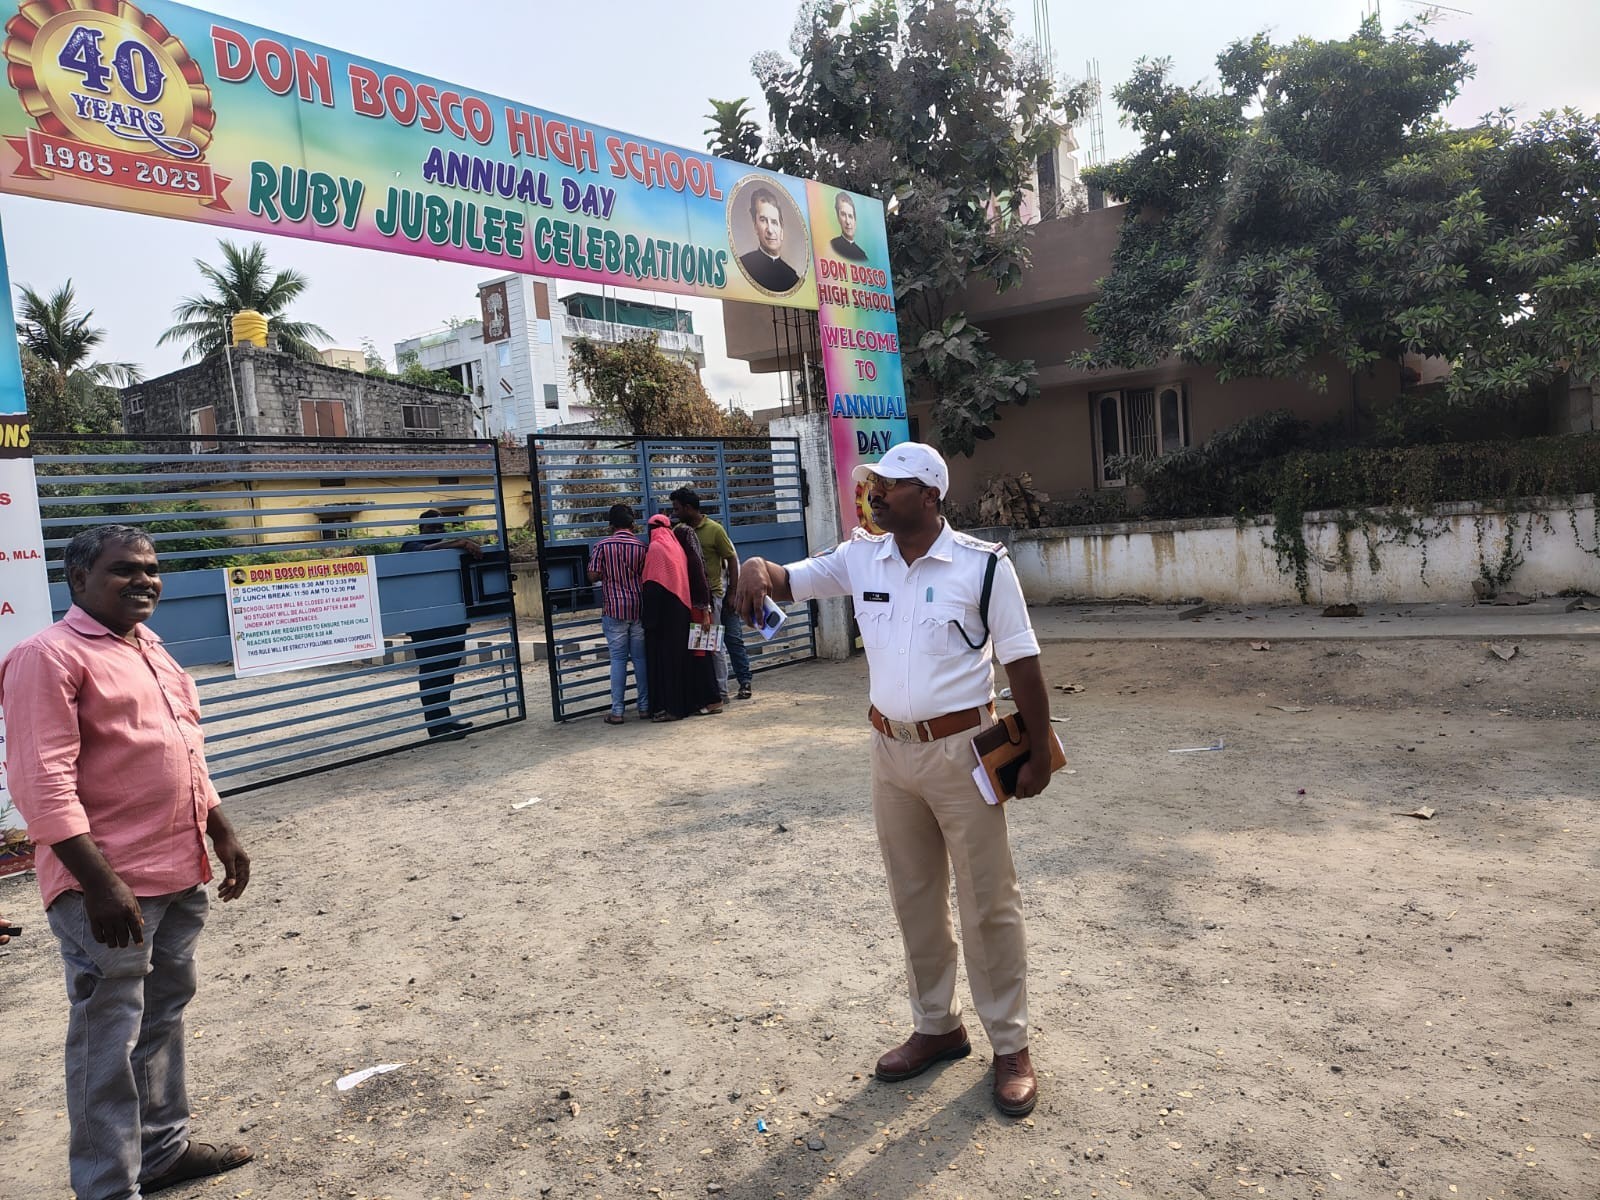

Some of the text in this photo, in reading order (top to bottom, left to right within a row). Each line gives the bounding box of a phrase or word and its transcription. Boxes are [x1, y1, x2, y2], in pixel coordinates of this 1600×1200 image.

[57, 25, 166, 103] 40
[210, 24, 722, 200] DON BOSCO HIGH SCHOOL
[43, 143, 114, 176] 1985
[136, 161, 200, 192] 2025
[422, 146, 616, 219] ANNUAL DAY
[249, 160, 728, 288] RUBY JUBILEE CELEBRATIONS
[820, 258, 886, 289] DON BOSCO
[818, 283, 895, 313] HIGH SCHOOL
[823, 325, 898, 353] WELCOME
[855, 359, 877, 381] TO
[832, 393, 906, 419] ANNUAL
[0, 423, 30, 448] NS
[856, 430, 891, 455] DAY
[13, 550, 41, 560] MLA.
[249, 560, 366, 581] DON BOSCO HIGH SCHOOL
[241, 585, 269, 594] SCHOOL
[242, 594, 266, 602] LUNCH
[1, 601, 15, 615] A
[242, 604, 264, 612] SCHOOL
[265, 602, 282, 610] GATES
[252, 611, 276, 619] STUDENT
[298, 606, 322, 614] ALLOWED
[245, 630, 269, 638] PARENTS
[282, 624, 312, 633] REQUESTED
